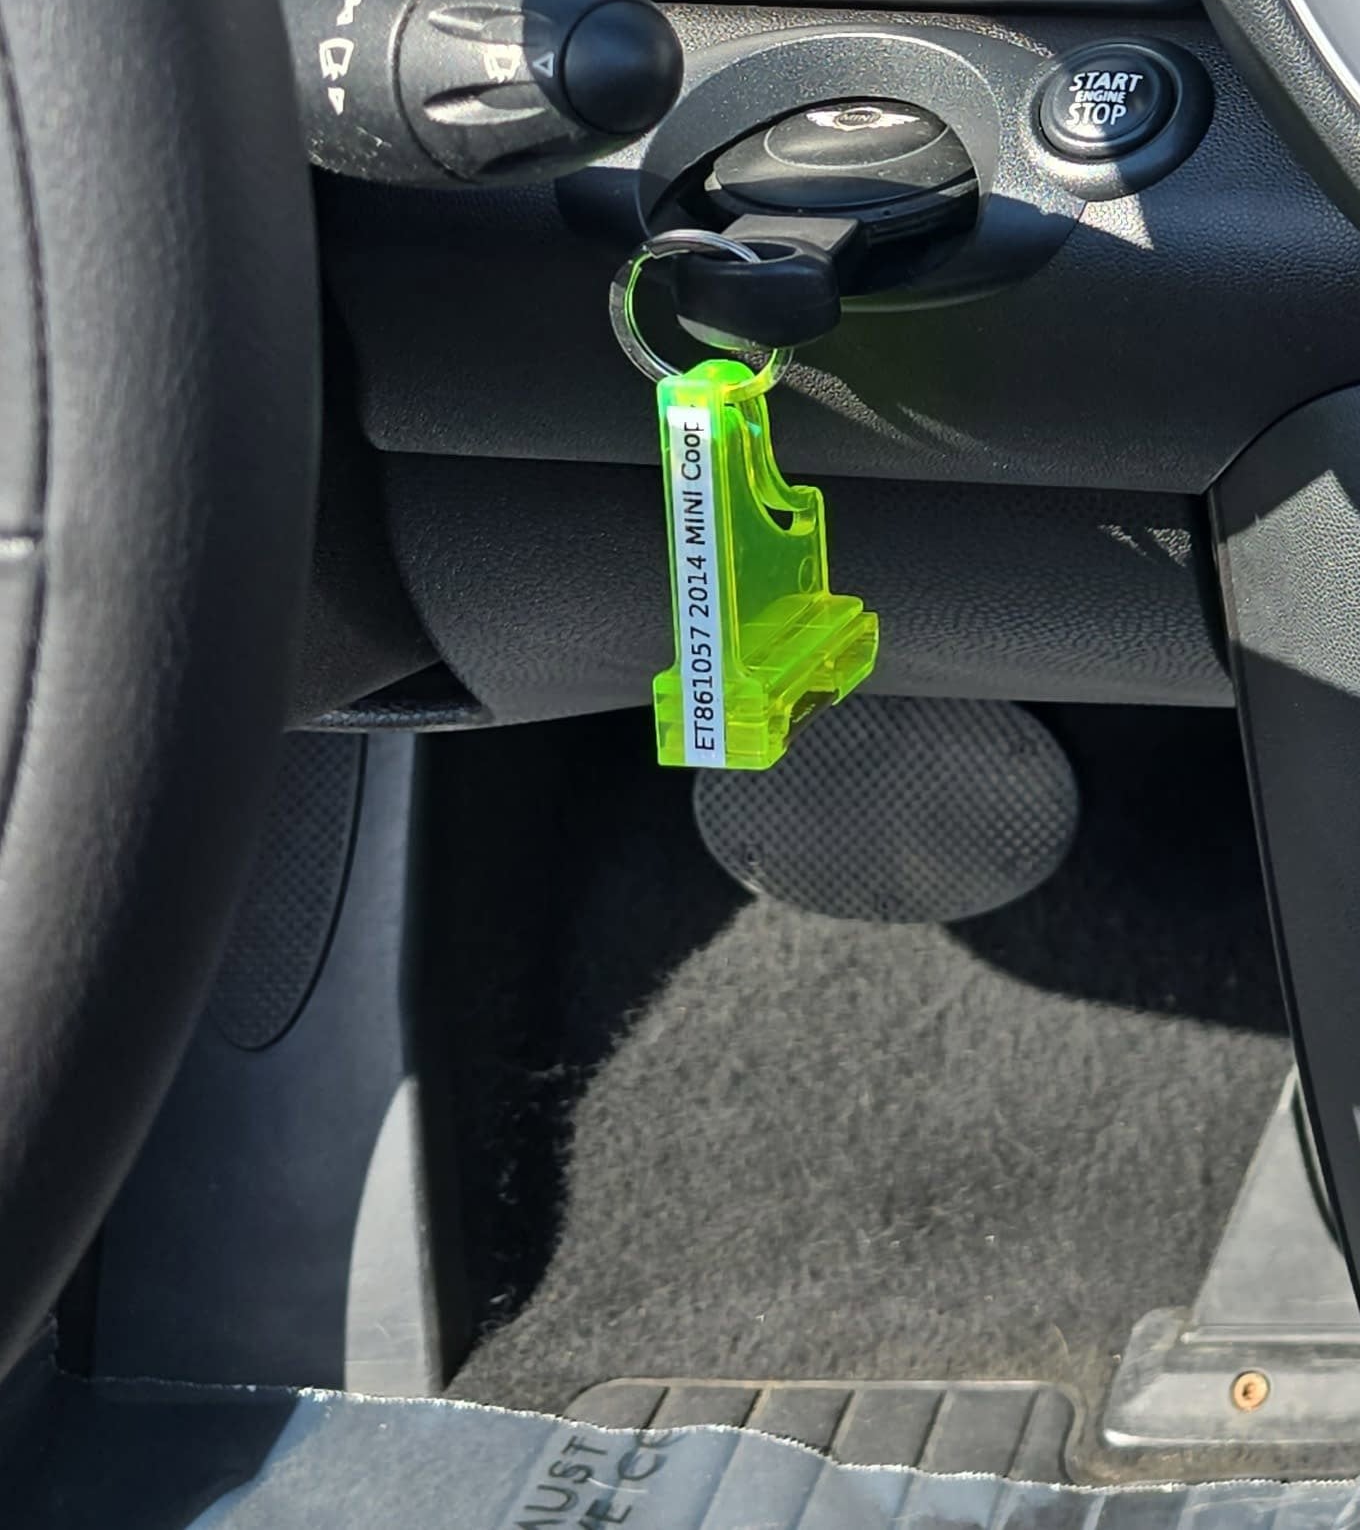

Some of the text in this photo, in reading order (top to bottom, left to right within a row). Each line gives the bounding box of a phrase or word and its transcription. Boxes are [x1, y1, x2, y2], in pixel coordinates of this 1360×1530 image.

[1068, 71, 1144, 93] START
[1074, 90, 1127, 104] ENGINE
[1065, 102, 1127, 126] STOP
[681, 490, 706, 545] MINI
[686, 555, 710, 618] 2014
[689, 626, 716, 751] ET861057
